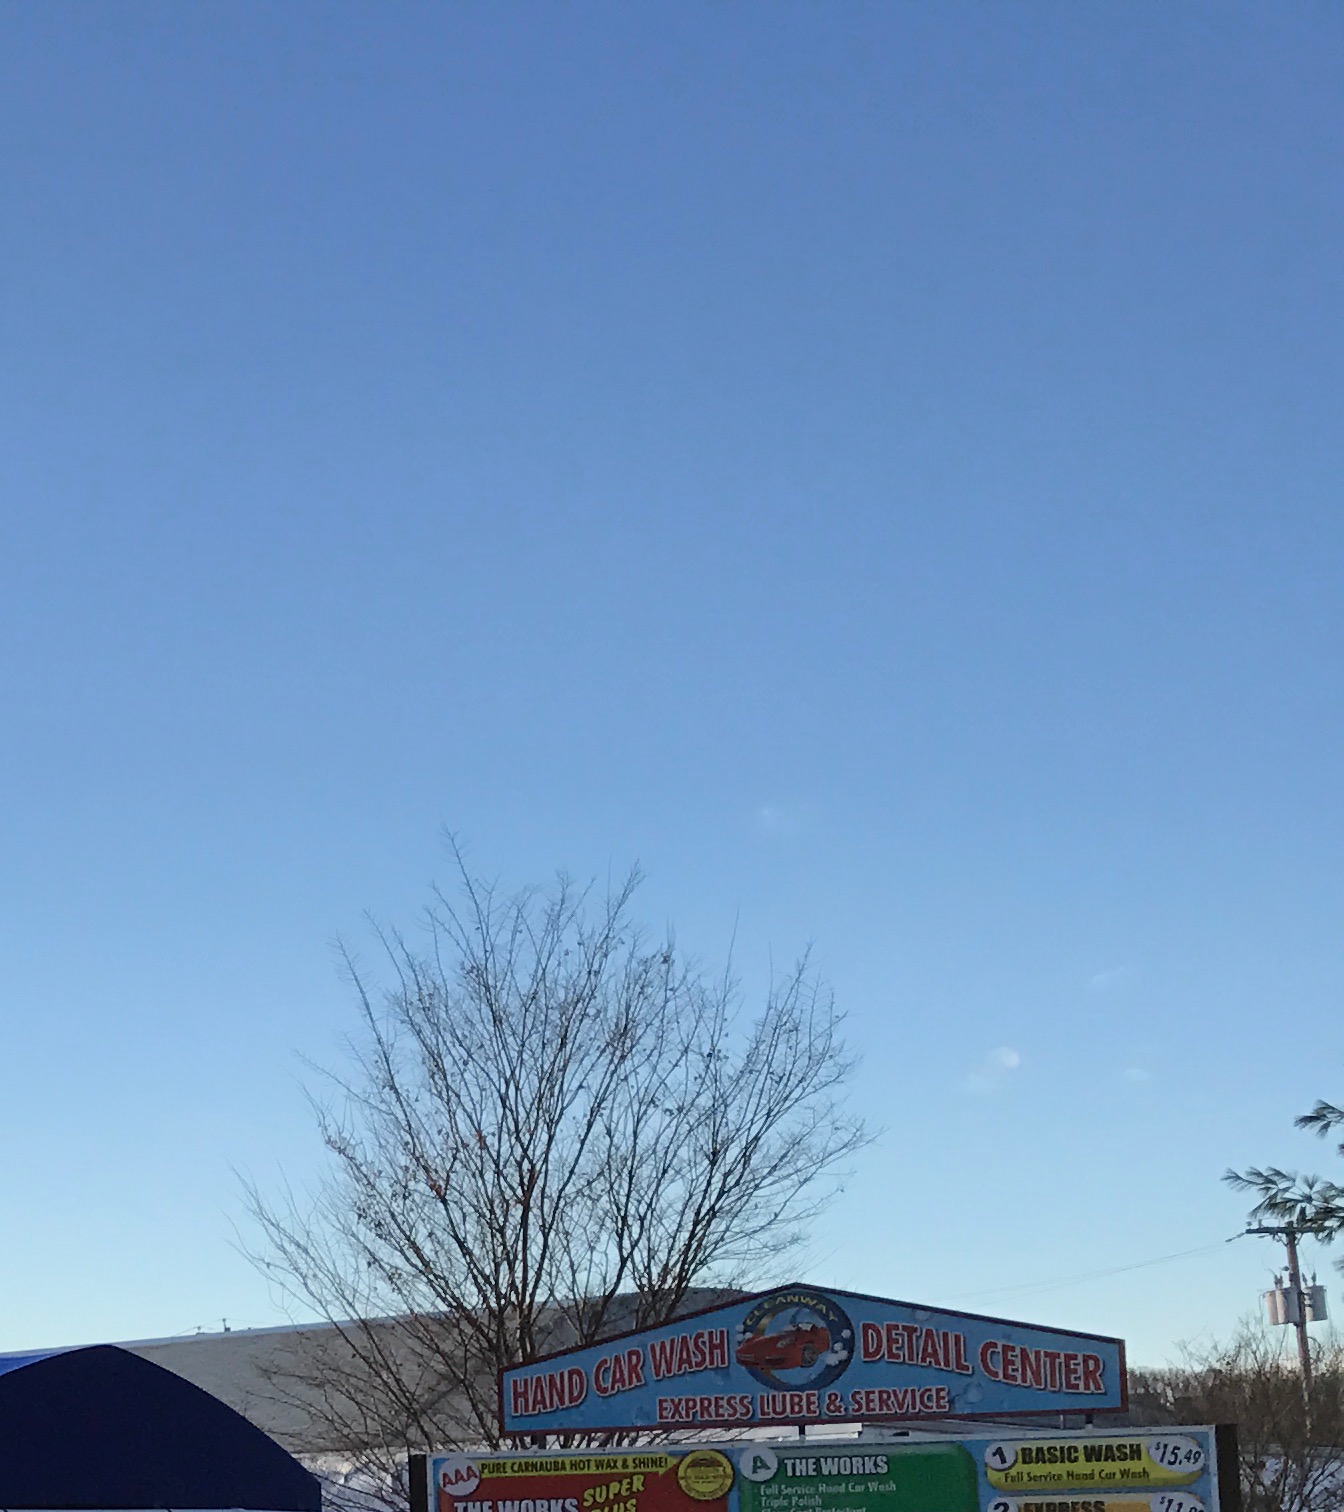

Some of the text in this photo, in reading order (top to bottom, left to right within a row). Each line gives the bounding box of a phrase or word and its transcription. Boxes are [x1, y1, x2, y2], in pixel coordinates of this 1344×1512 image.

[860, 1321, 1105, 1394] DETAIL CENTER
[512, 1329, 728, 1416] HAND CAR WASH
[658, 1386, 949, 1422] EXPRESS LUBE & SERVICE
[752, 1456, 771, 1474] A
[992, 1446, 1007, 1465] 1
[1021, 1443, 1141, 1465] BASIC WASH
[1155, 1442, 1202, 1466] $15.49
[442, 1466, 478, 1488] AAA
[481, 1456, 668, 1476] PURE CARNAUBA HOT WAX & SHINE!
[785, 1456, 889, 1476] THE WORKS
[1004, 1468, 1149, 1483] Full Service Hand Car Wash
[582, 1474, 644, 1507] SUPER
